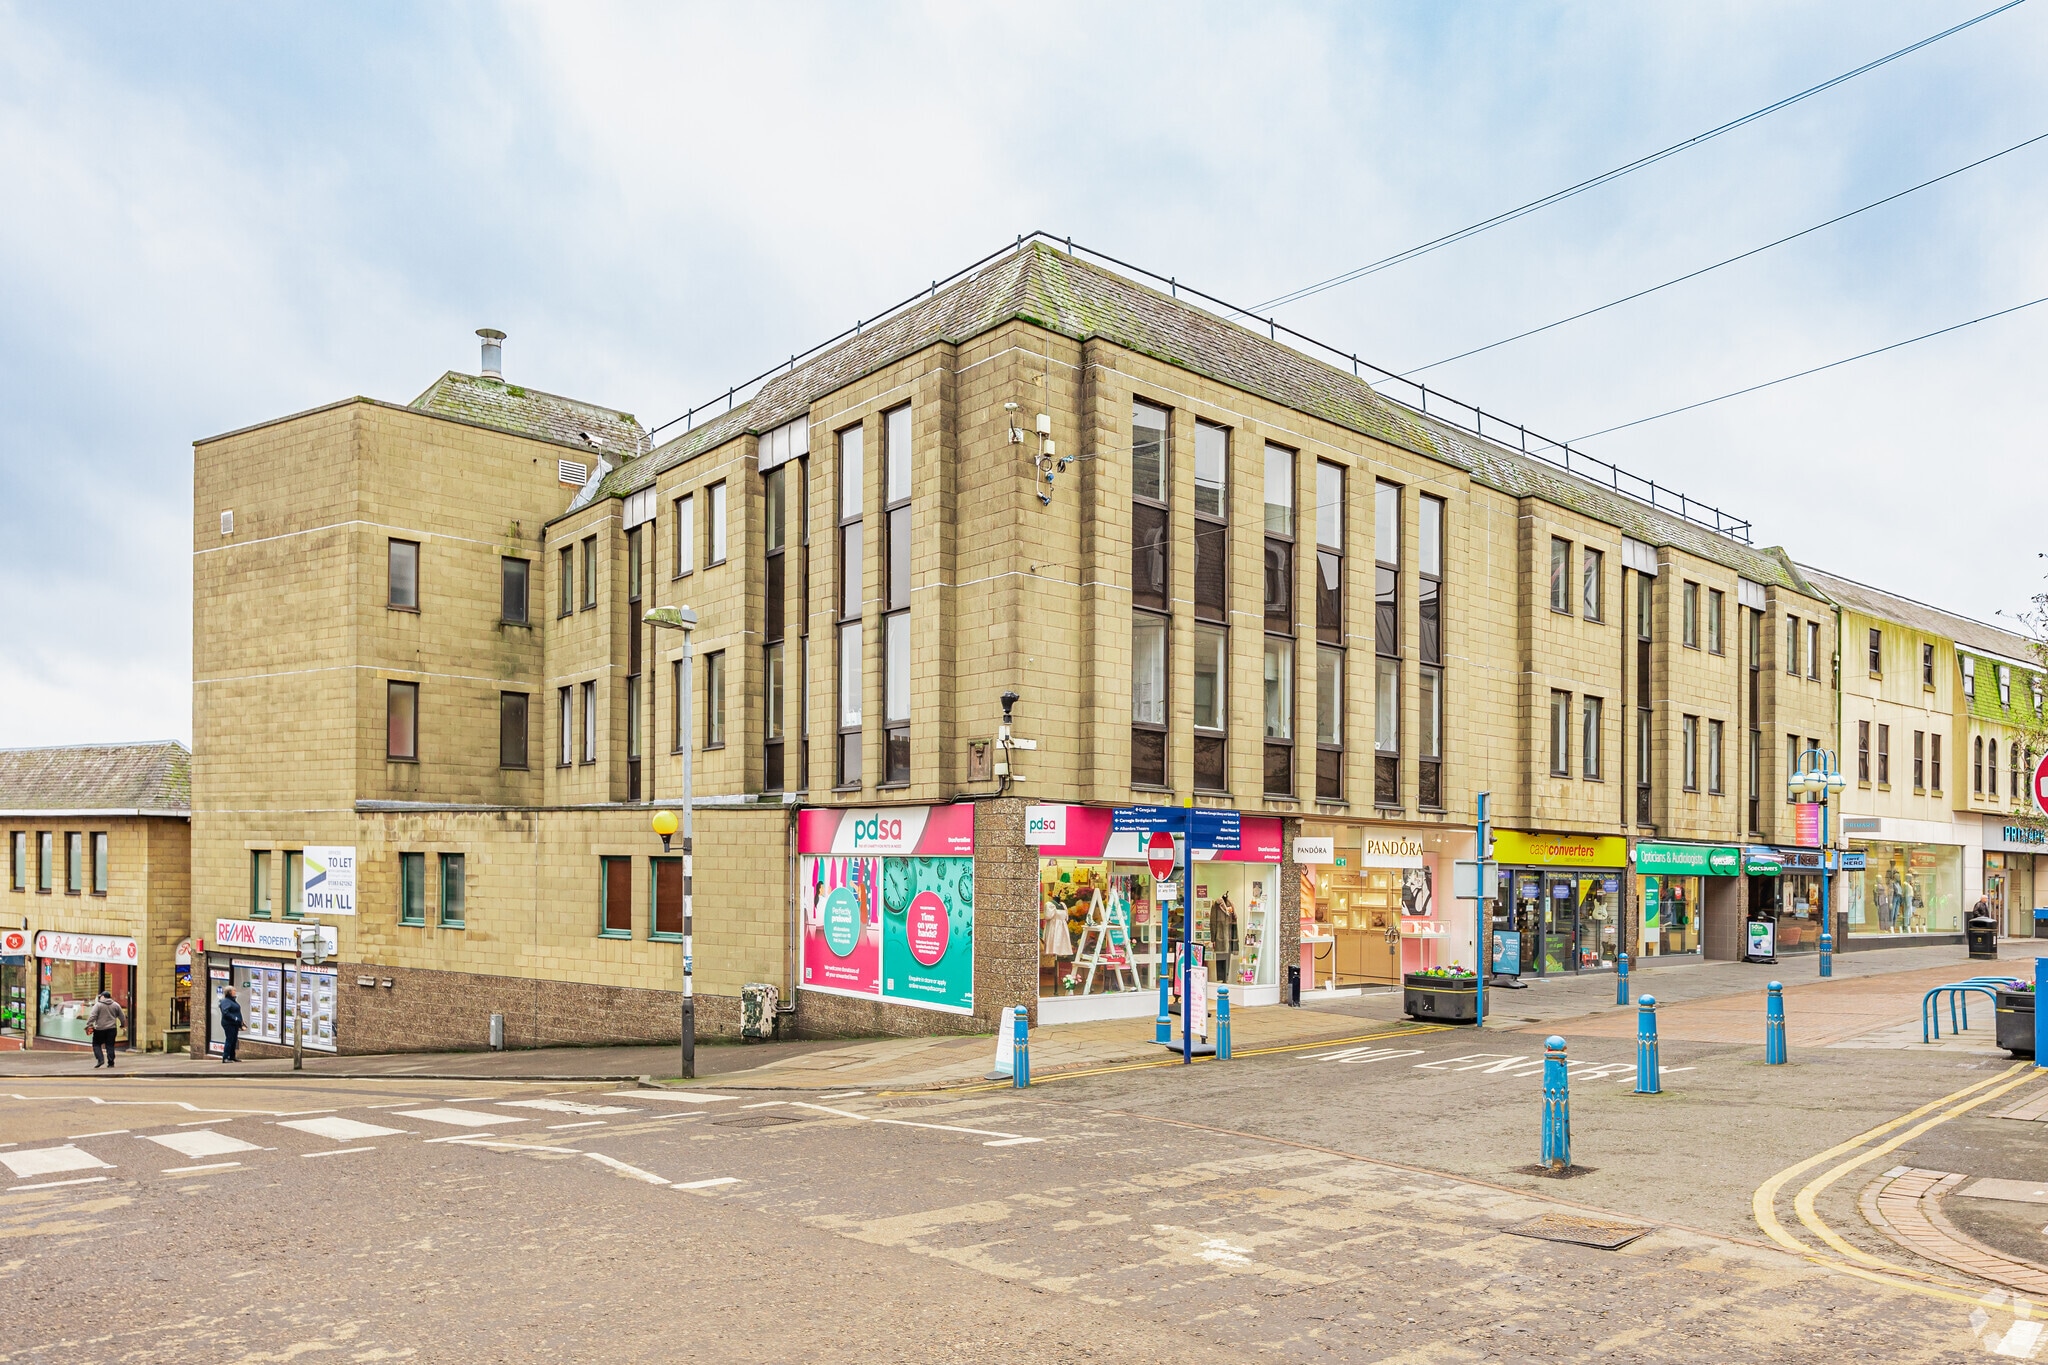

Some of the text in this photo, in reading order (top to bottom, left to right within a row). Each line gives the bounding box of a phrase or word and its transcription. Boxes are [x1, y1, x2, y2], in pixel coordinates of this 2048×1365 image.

[854, 813, 901, 848] pdsa
[1030, 817, 1055, 833] pdsa
[328, 858, 352, 868] TO LET
[1641, 851, 1703, 866] Opticians & Audiologists
[308, 893, 352, 909] DM HALL
[921, 912, 934, 921] Time
[219, 923, 256, 943] RE/MAX
[259, 936, 292, 946] PROPERTY
[918, 929, 937, 938] hands?
[53, 936, 71, 955] Ruby
[74, 938, 93, 955] Nails
[107, 940, 121, 958] Spa
[1296, 1047, 1697, 1083] NO ENTRY
